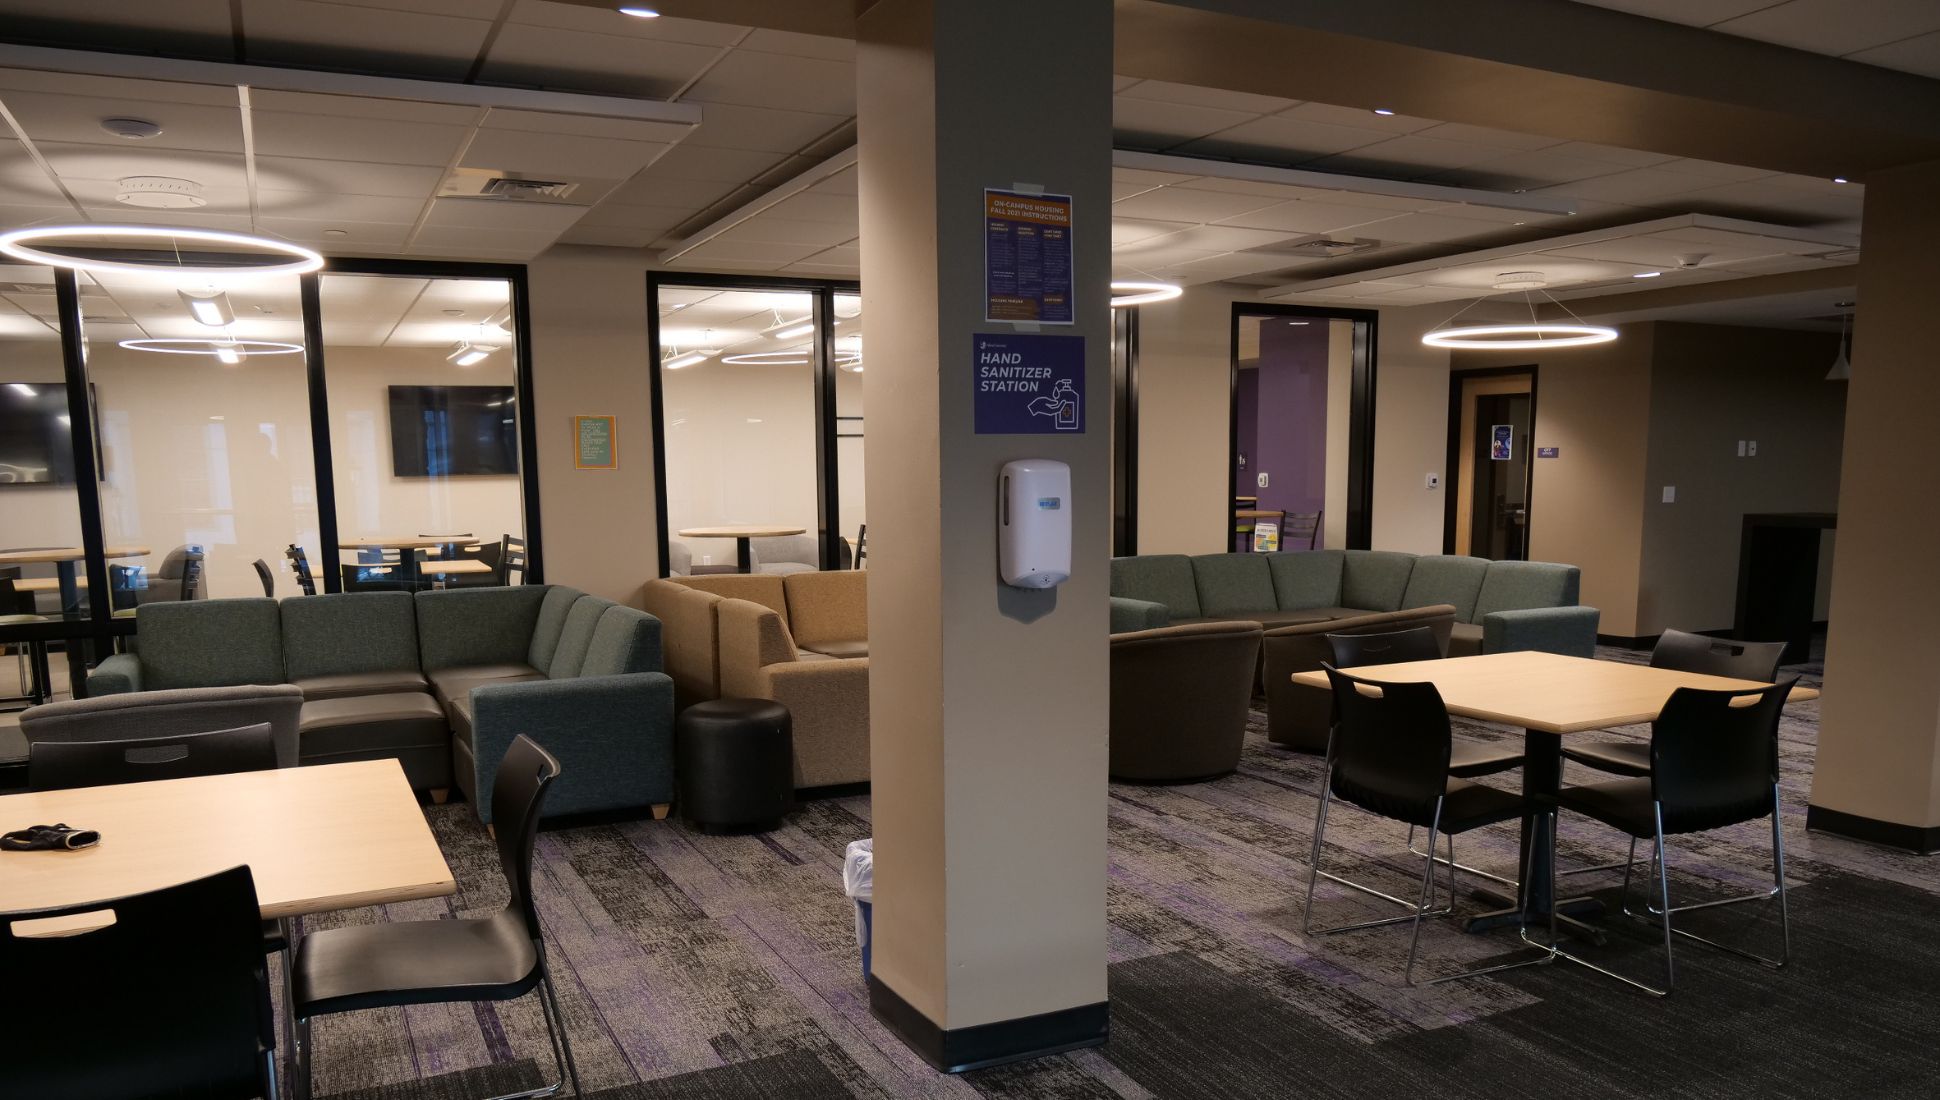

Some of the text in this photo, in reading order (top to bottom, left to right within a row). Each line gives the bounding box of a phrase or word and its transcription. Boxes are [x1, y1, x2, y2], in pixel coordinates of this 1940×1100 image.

[994, 200, 1065, 214] ON-CAMPUS HOUSING
[990, 207, 1006, 215] FALL
[1021, 210, 1068, 222] INSTRUCTIONS
[980, 352, 1022, 364] HAND
[980, 366, 1052, 378] SANITIZER
[980, 380, 1039, 392] STATION
